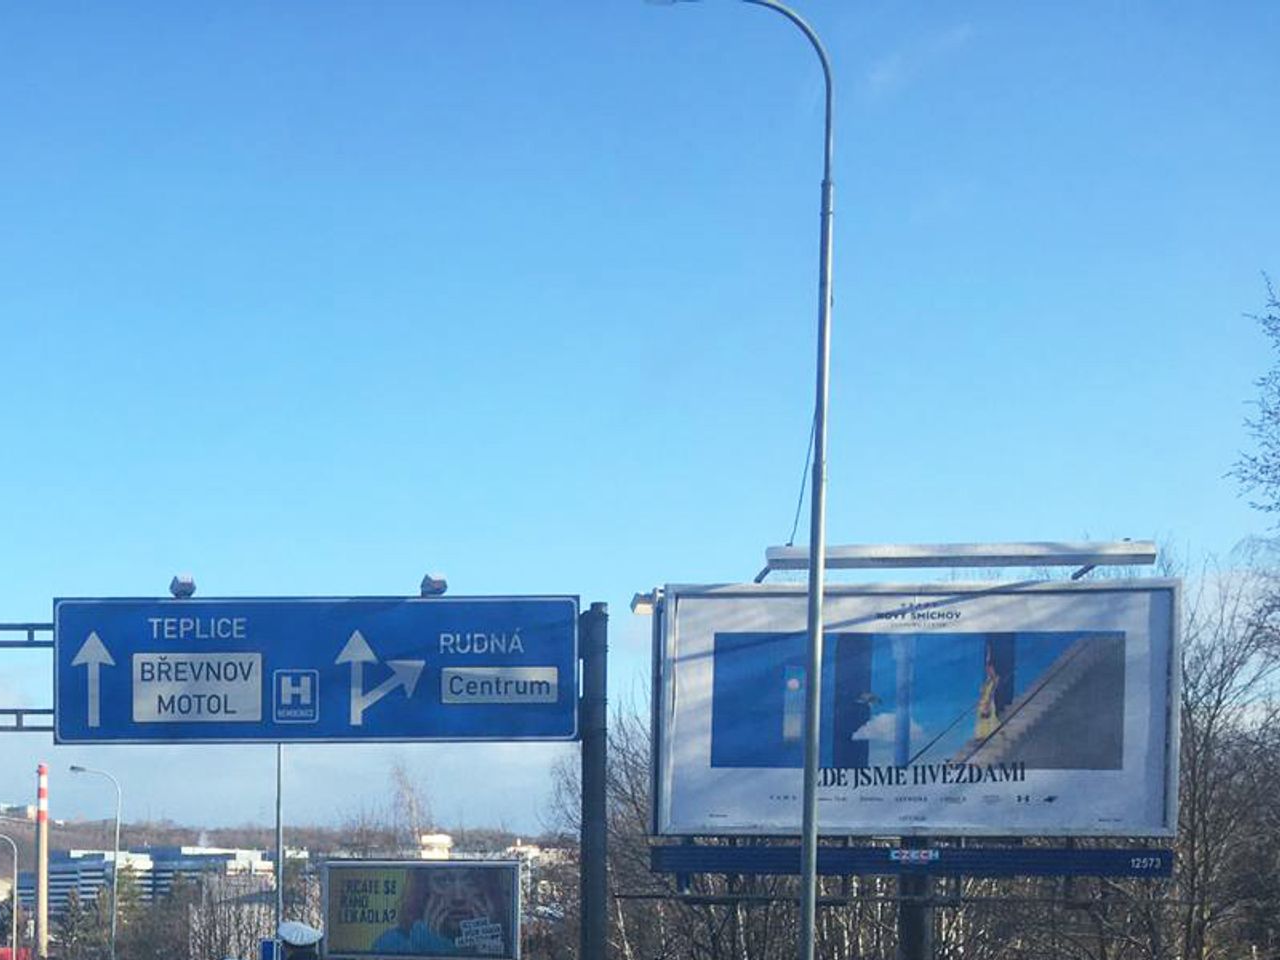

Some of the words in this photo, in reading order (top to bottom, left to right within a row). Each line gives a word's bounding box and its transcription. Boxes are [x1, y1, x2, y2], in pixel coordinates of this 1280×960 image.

[149, 618, 247, 640] TEPLICE
[439, 627, 525, 655] RUDNÁ
[140, 656, 254, 683] BŘEVNOV
[281, 676, 311, 705] H
[449, 675, 551, 697] Centrum
[157, 695, 237, 716] MOTOL
[853, 765, 908, 789] JSME
[913, 759, 1026, 786] HVĚZDAMI
